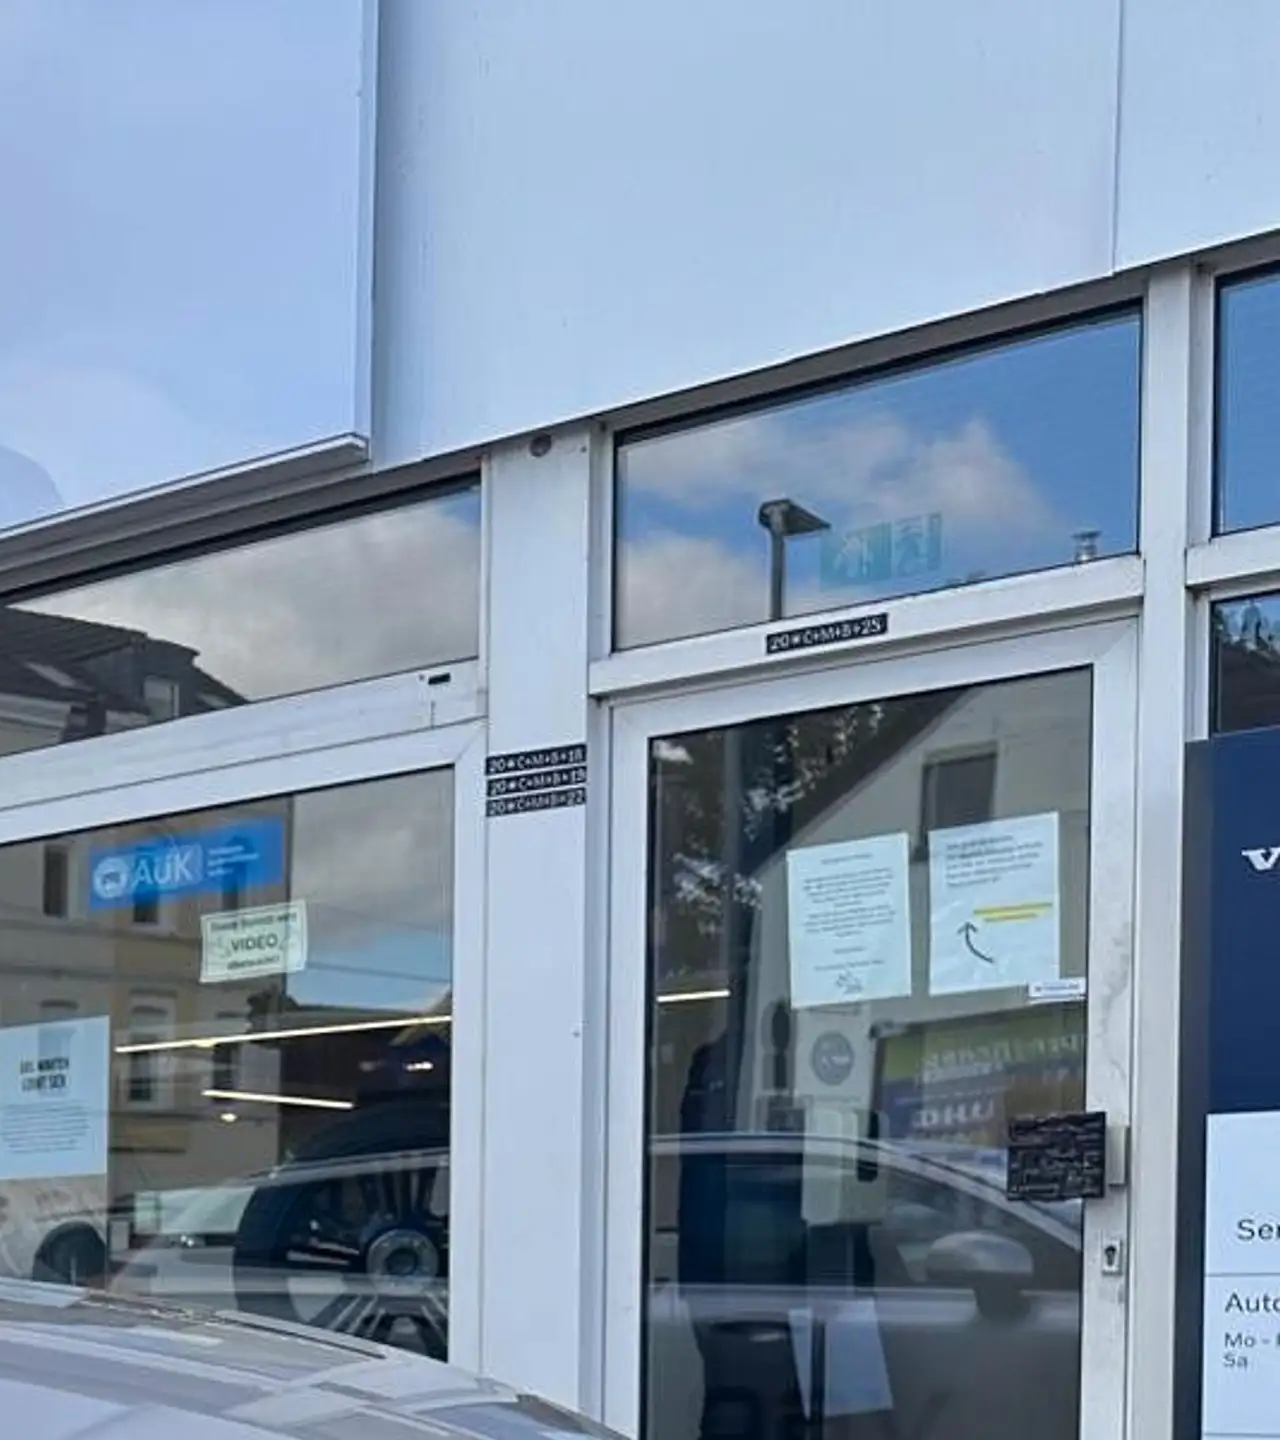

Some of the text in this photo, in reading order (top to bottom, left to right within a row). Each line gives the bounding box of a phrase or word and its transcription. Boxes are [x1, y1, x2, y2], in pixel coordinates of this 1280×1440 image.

[231, 933, 278, 951] VIDEO
[1224, 1331, 1256, 1349] Mo
[1224, 1352, 1248, 1369] Sa
